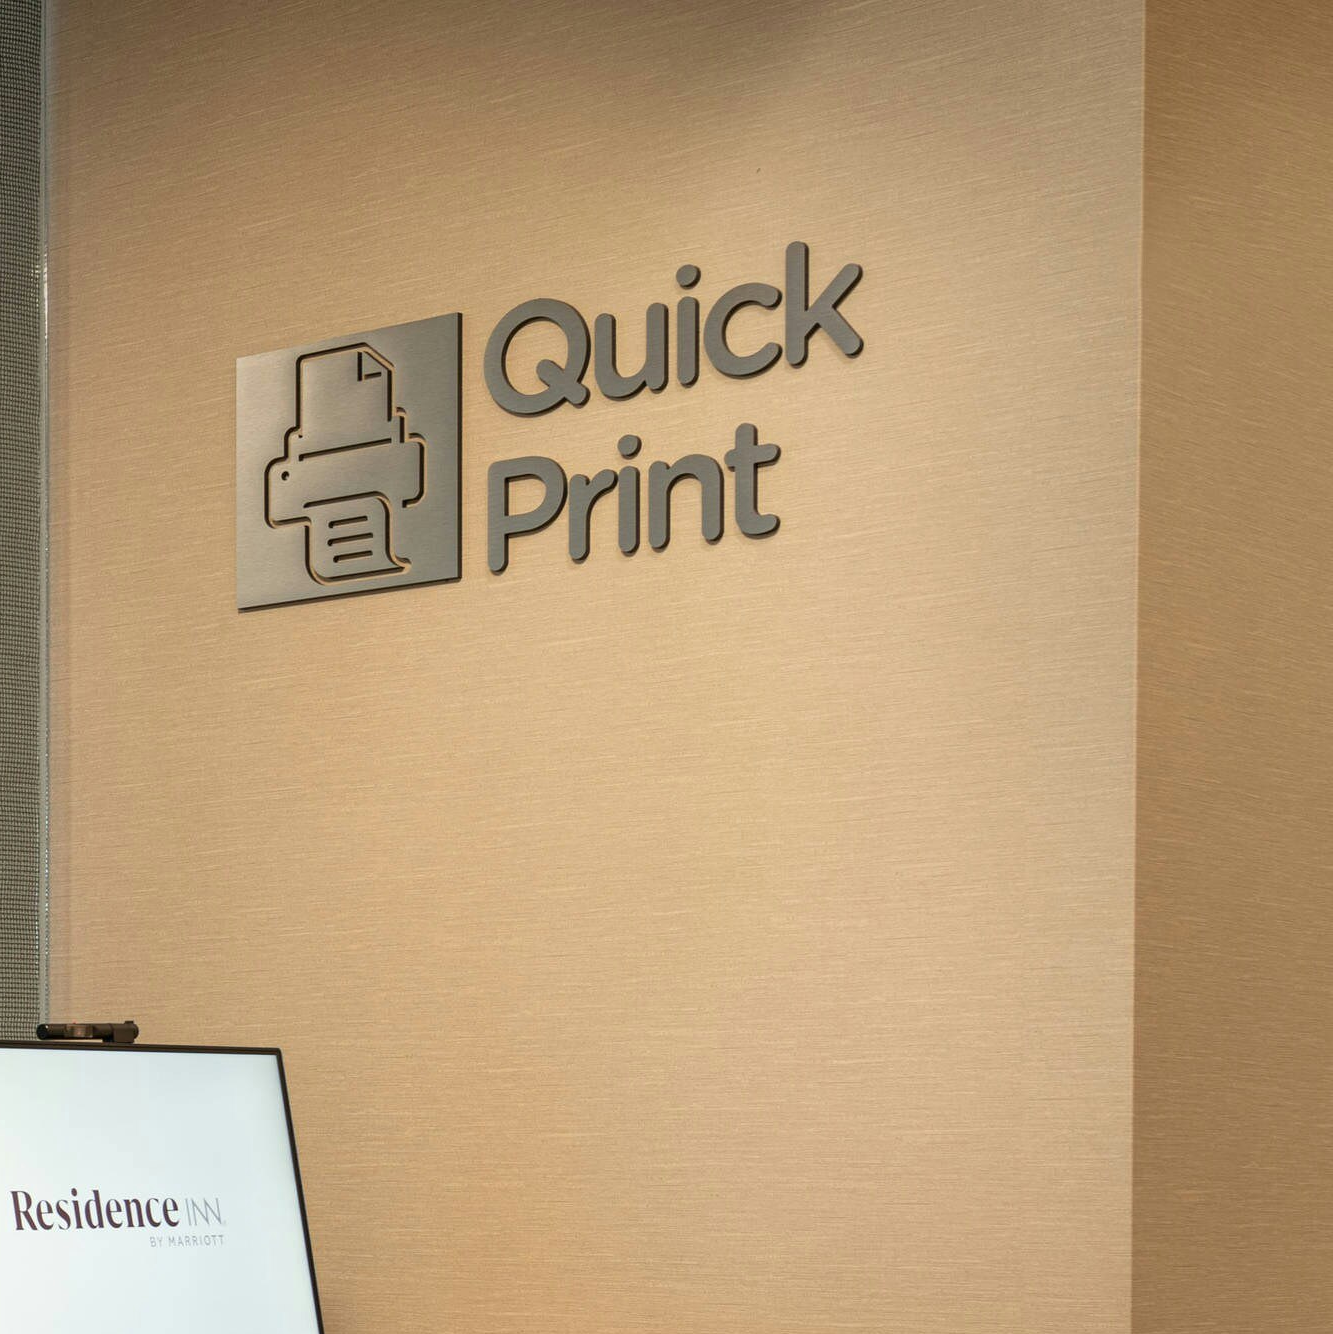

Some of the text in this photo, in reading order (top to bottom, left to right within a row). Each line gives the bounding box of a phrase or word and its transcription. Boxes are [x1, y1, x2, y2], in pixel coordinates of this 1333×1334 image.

[484, 241, 863, 417] Quick
[488, 423, 781, 573] Print
[10, 1188, 222, 1231] Residence INN
[150, 1235, 225, 1248] BY MARRIOTT
